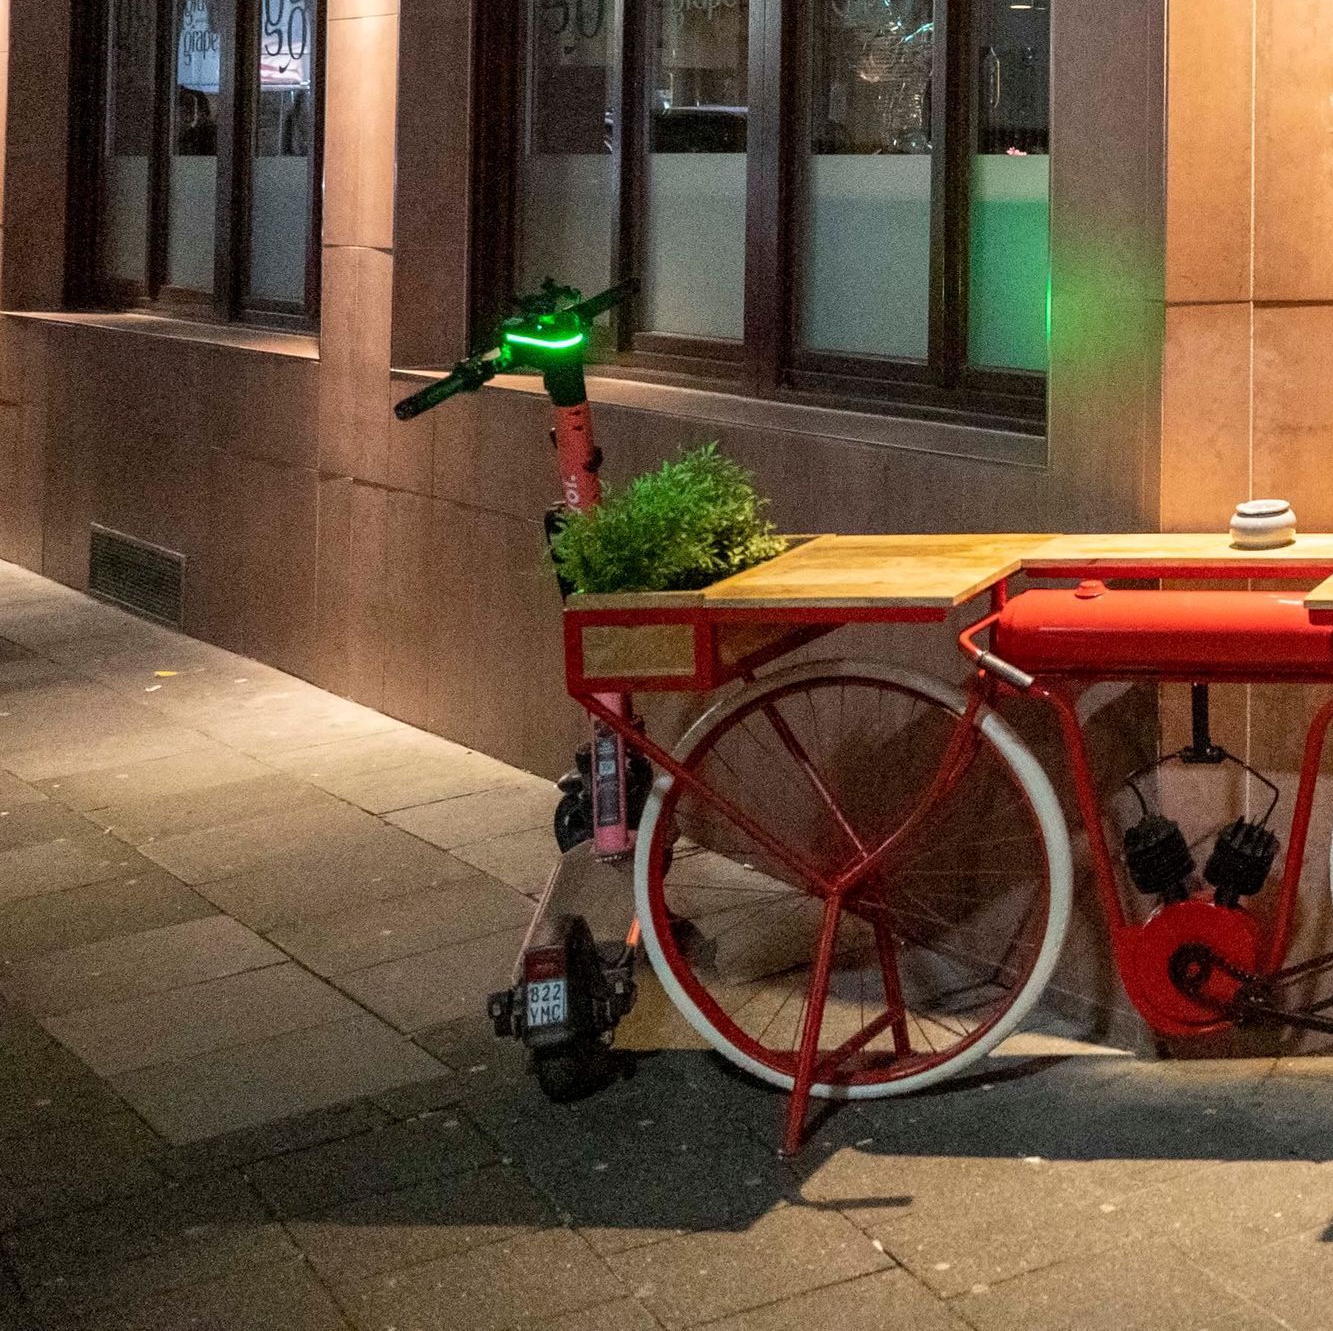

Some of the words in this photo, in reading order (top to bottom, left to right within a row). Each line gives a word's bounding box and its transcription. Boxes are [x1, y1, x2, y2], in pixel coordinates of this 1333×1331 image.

[182, 29, 219, 67] grape
[531, 984, 561, 1003] 822
[530, 1004, 561, 1024] YMC
